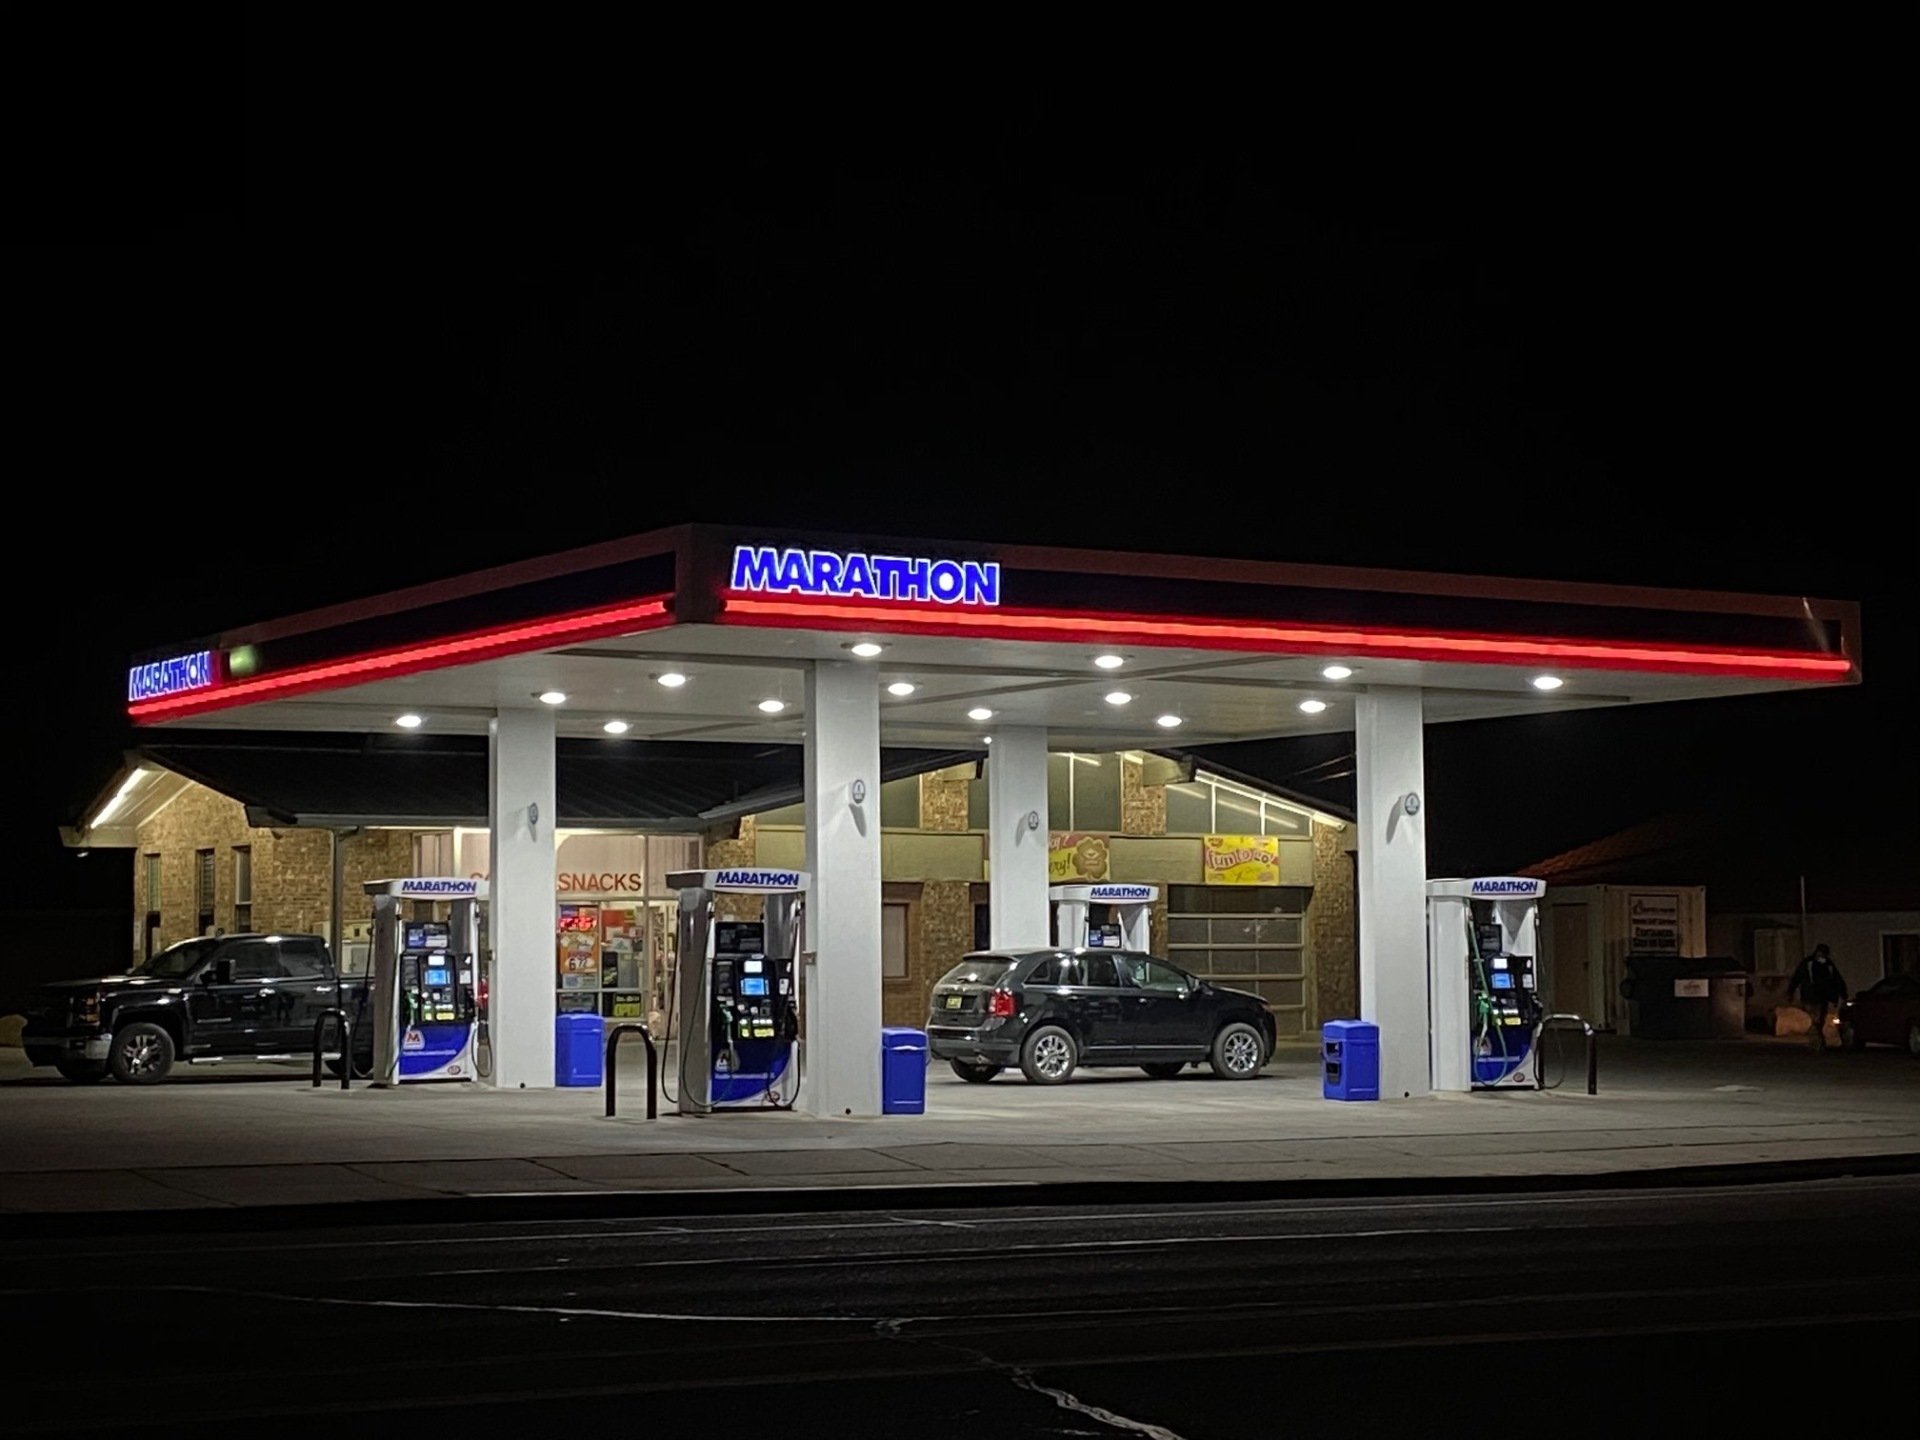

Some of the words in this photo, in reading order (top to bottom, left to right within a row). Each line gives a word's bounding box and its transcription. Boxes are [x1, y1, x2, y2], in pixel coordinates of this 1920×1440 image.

[731, 546, 1000, 605] MARATHON
[128, 651, 211, 702] MARATHON
[558, 873, 642, 891] SNACKS
[715, 871, 799, 886] MARATHON
[402, 881, 477, 892] MARATHON
[1090, 887, 1150, 897] MARATHON
[1471, 881, 1538, 892] MARATHON
